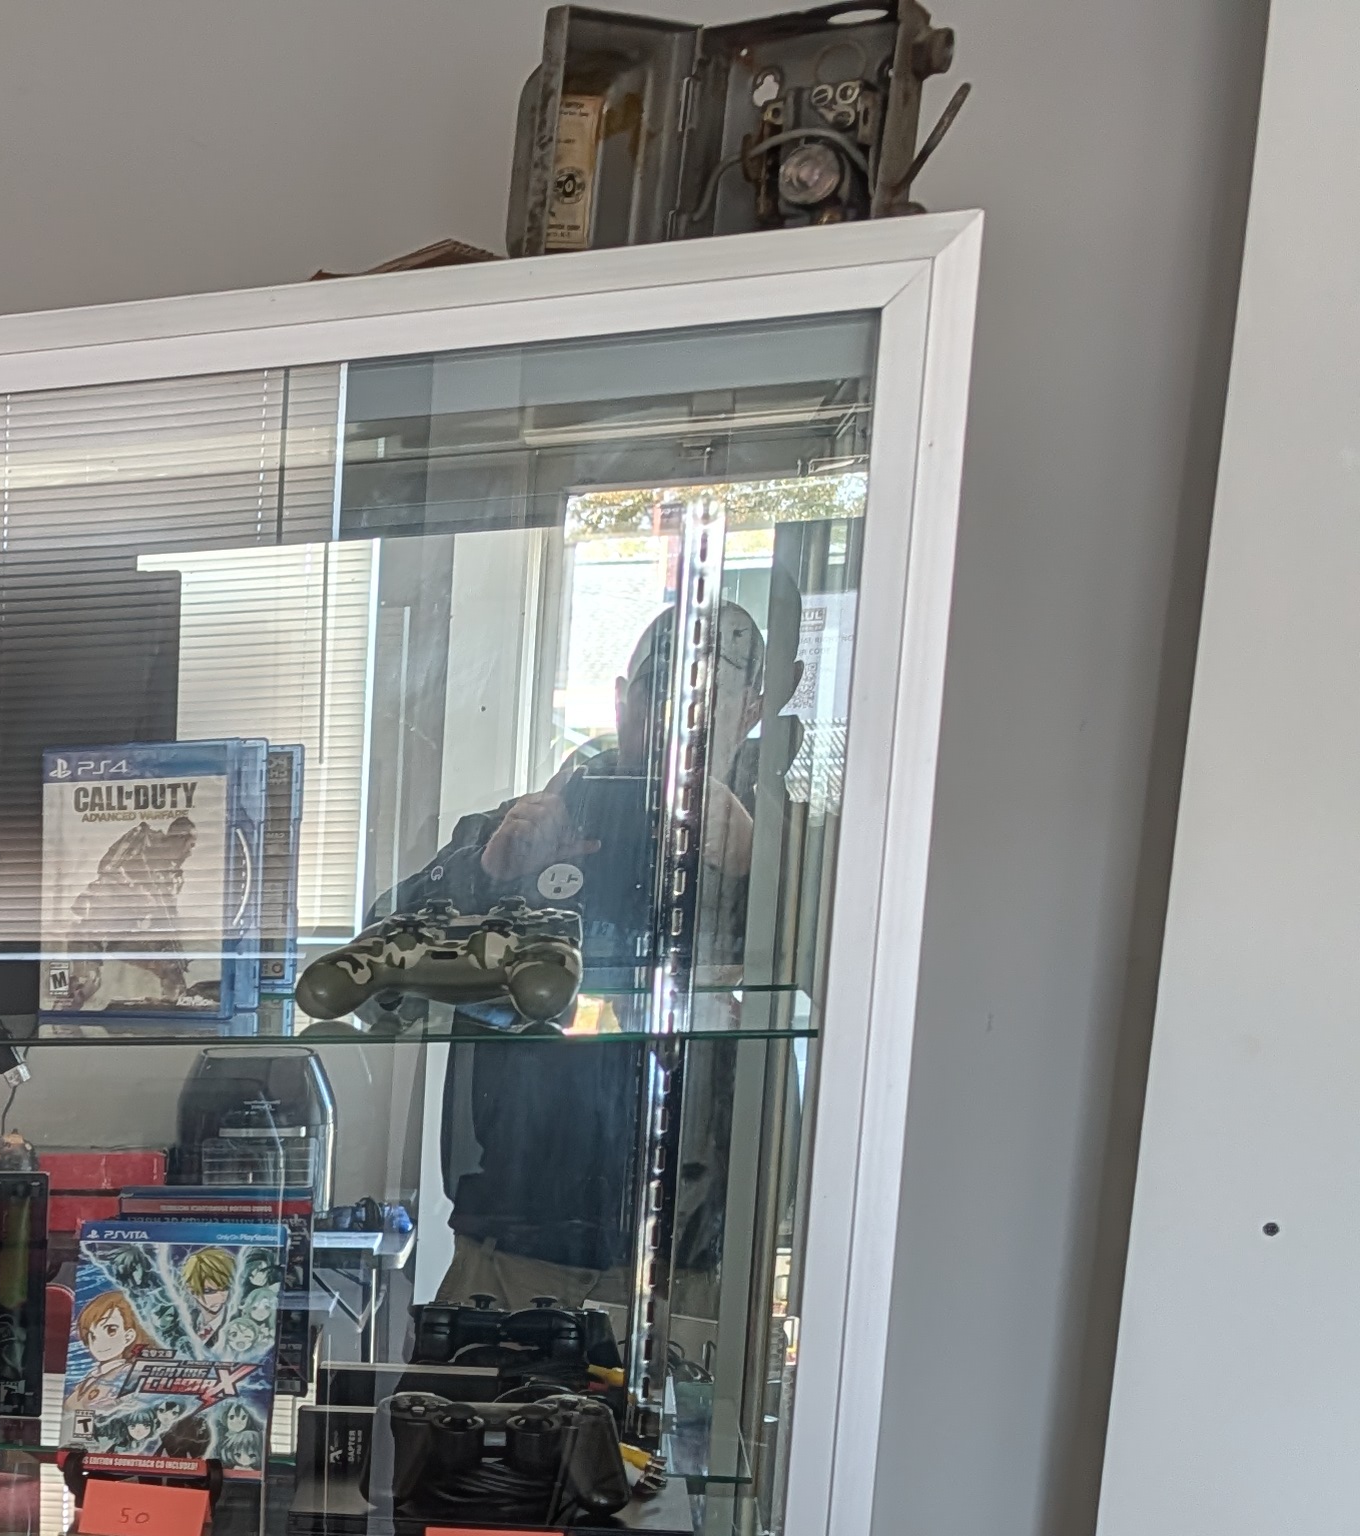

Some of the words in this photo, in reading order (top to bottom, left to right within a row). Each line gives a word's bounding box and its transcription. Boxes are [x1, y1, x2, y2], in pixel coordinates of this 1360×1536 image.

[77, 759, 129, 776] PS4
[73, 784, 127, 813] CALL
[133, 781, 198, 811] DUTY
[81, 811, 137, 823] ADVANCED
[51, 972, 67, 990] M
[240, 1233, 278, 1242] PlayStation
[132, 1362, 208, 1384] FIGHTING
[78, 1420, 92, 1434] T
[91, 1456, 112, 1466] EDITION
[113, 1457, 154, 1468] SOUNDTRACK
[119, 1506, 151, 1525] 50
